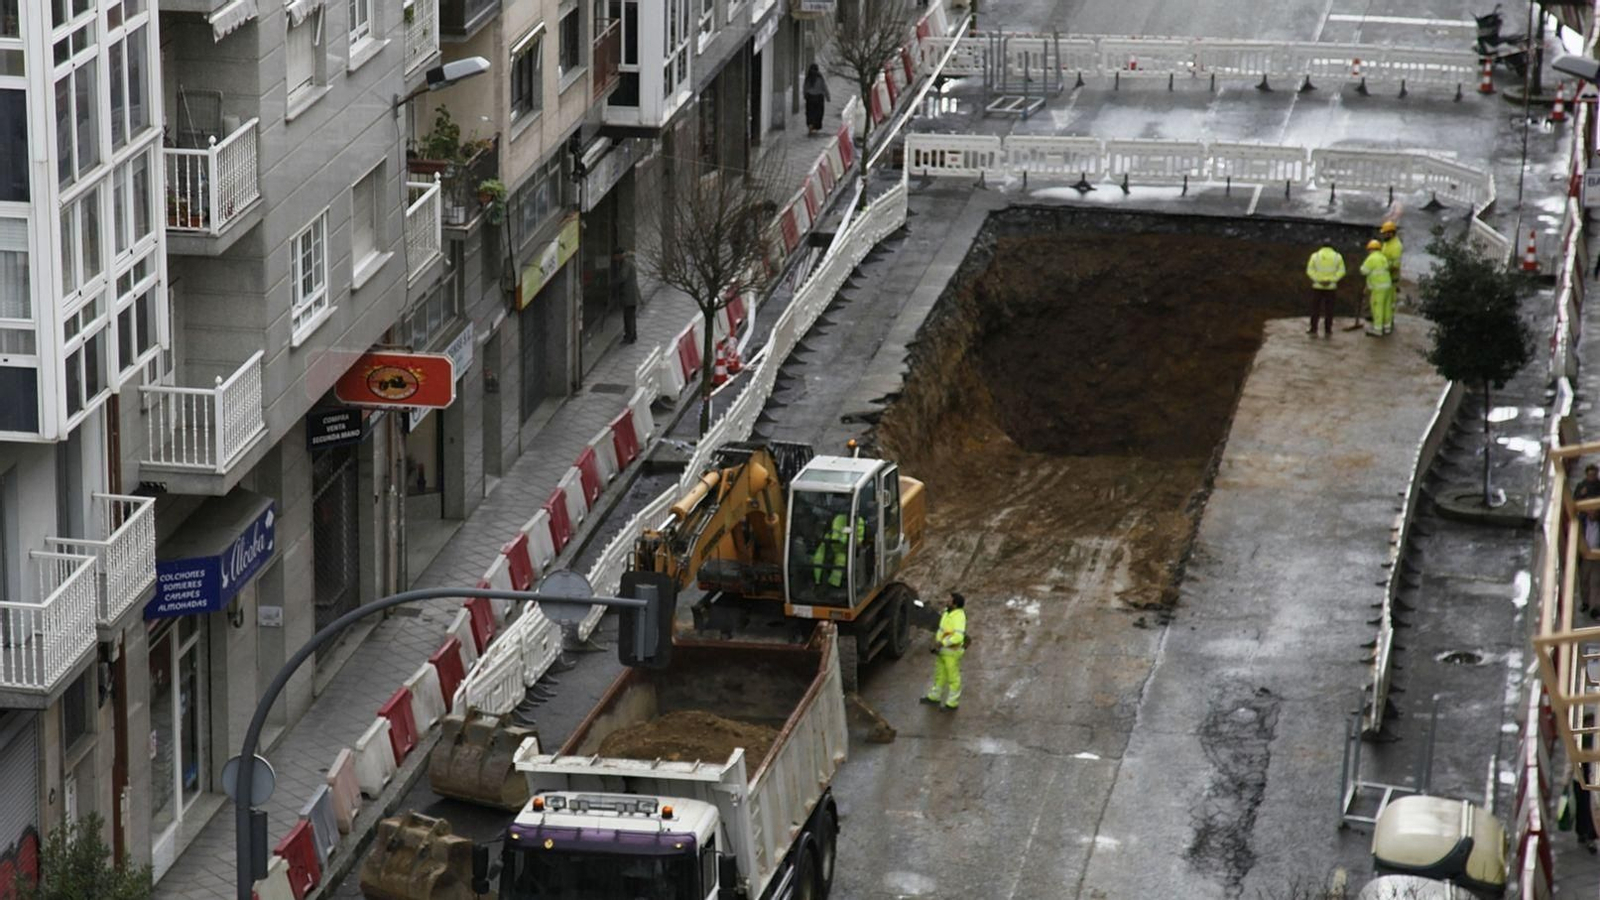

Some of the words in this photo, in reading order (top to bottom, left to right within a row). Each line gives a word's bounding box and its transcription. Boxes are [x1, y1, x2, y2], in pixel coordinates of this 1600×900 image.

[322, 413, 349, 425] COMPRA
[326, 422, 346, 433] VENTA
[340, 429, 360, 439] MANO
[160, 570, 205, 582] COLCHONES
[163, 580, 202, 592] SOMIERES
[158, 599, 207, 612] ALMOHADAS
